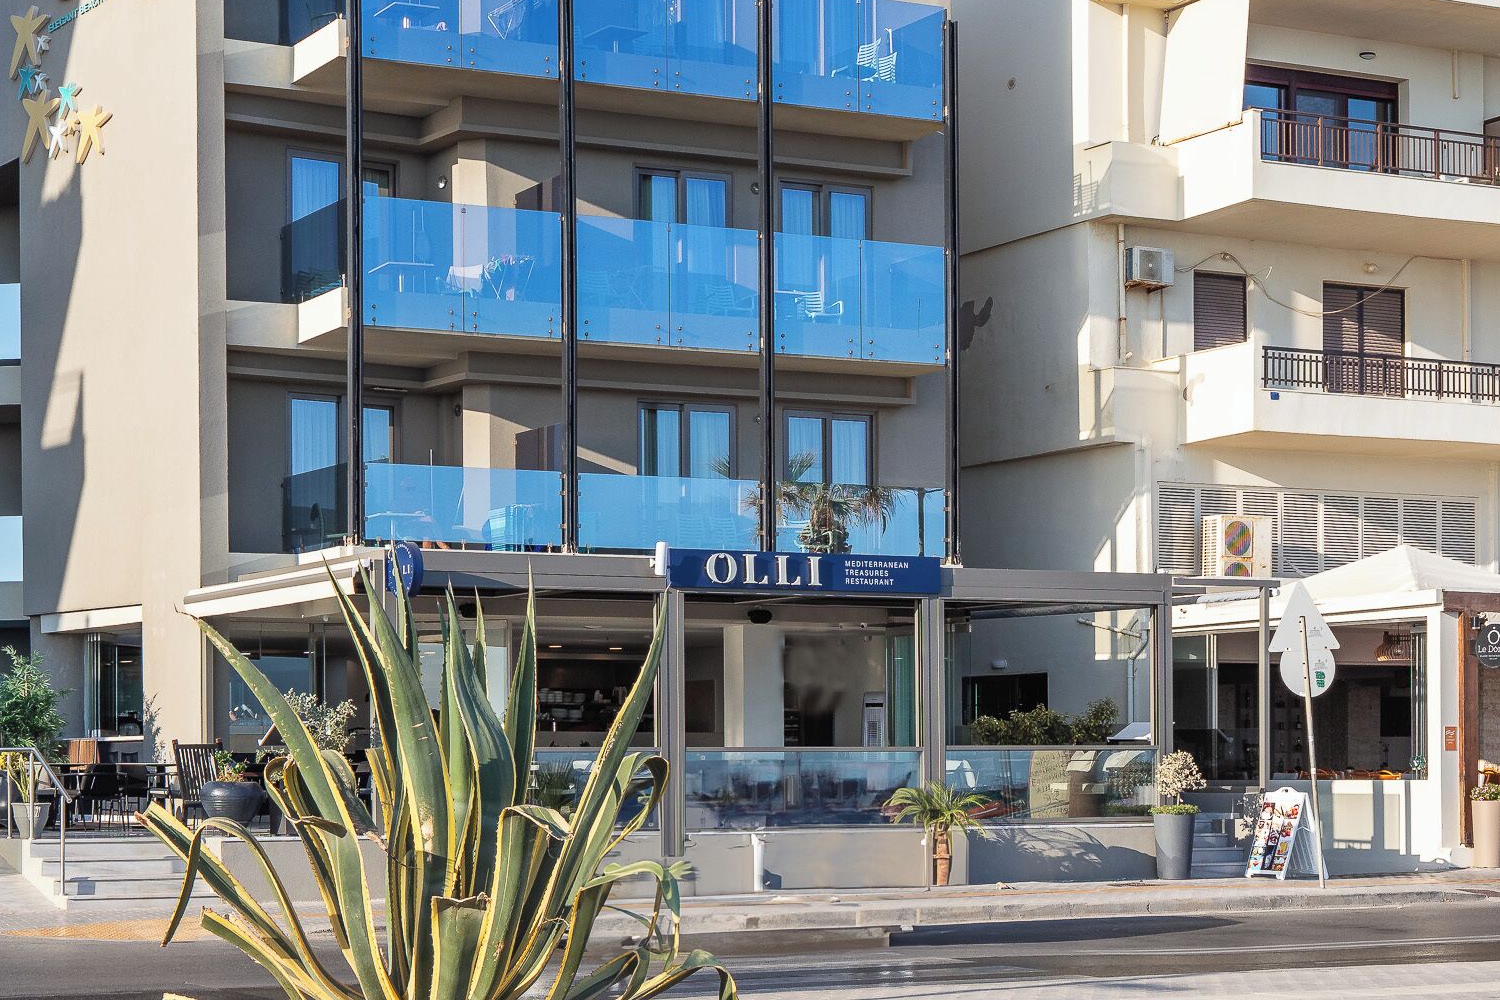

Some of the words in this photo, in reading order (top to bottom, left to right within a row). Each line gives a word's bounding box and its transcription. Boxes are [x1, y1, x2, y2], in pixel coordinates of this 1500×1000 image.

[47, 6, 79, 33] ELEGANT
[844, 560, 909, 569] MEDITERRANEAN
[705, 552, 823, 587] OLLI
[844, 569, 889, 577] TREASURES
[844, 578, 894, 586] RESTAURANT
